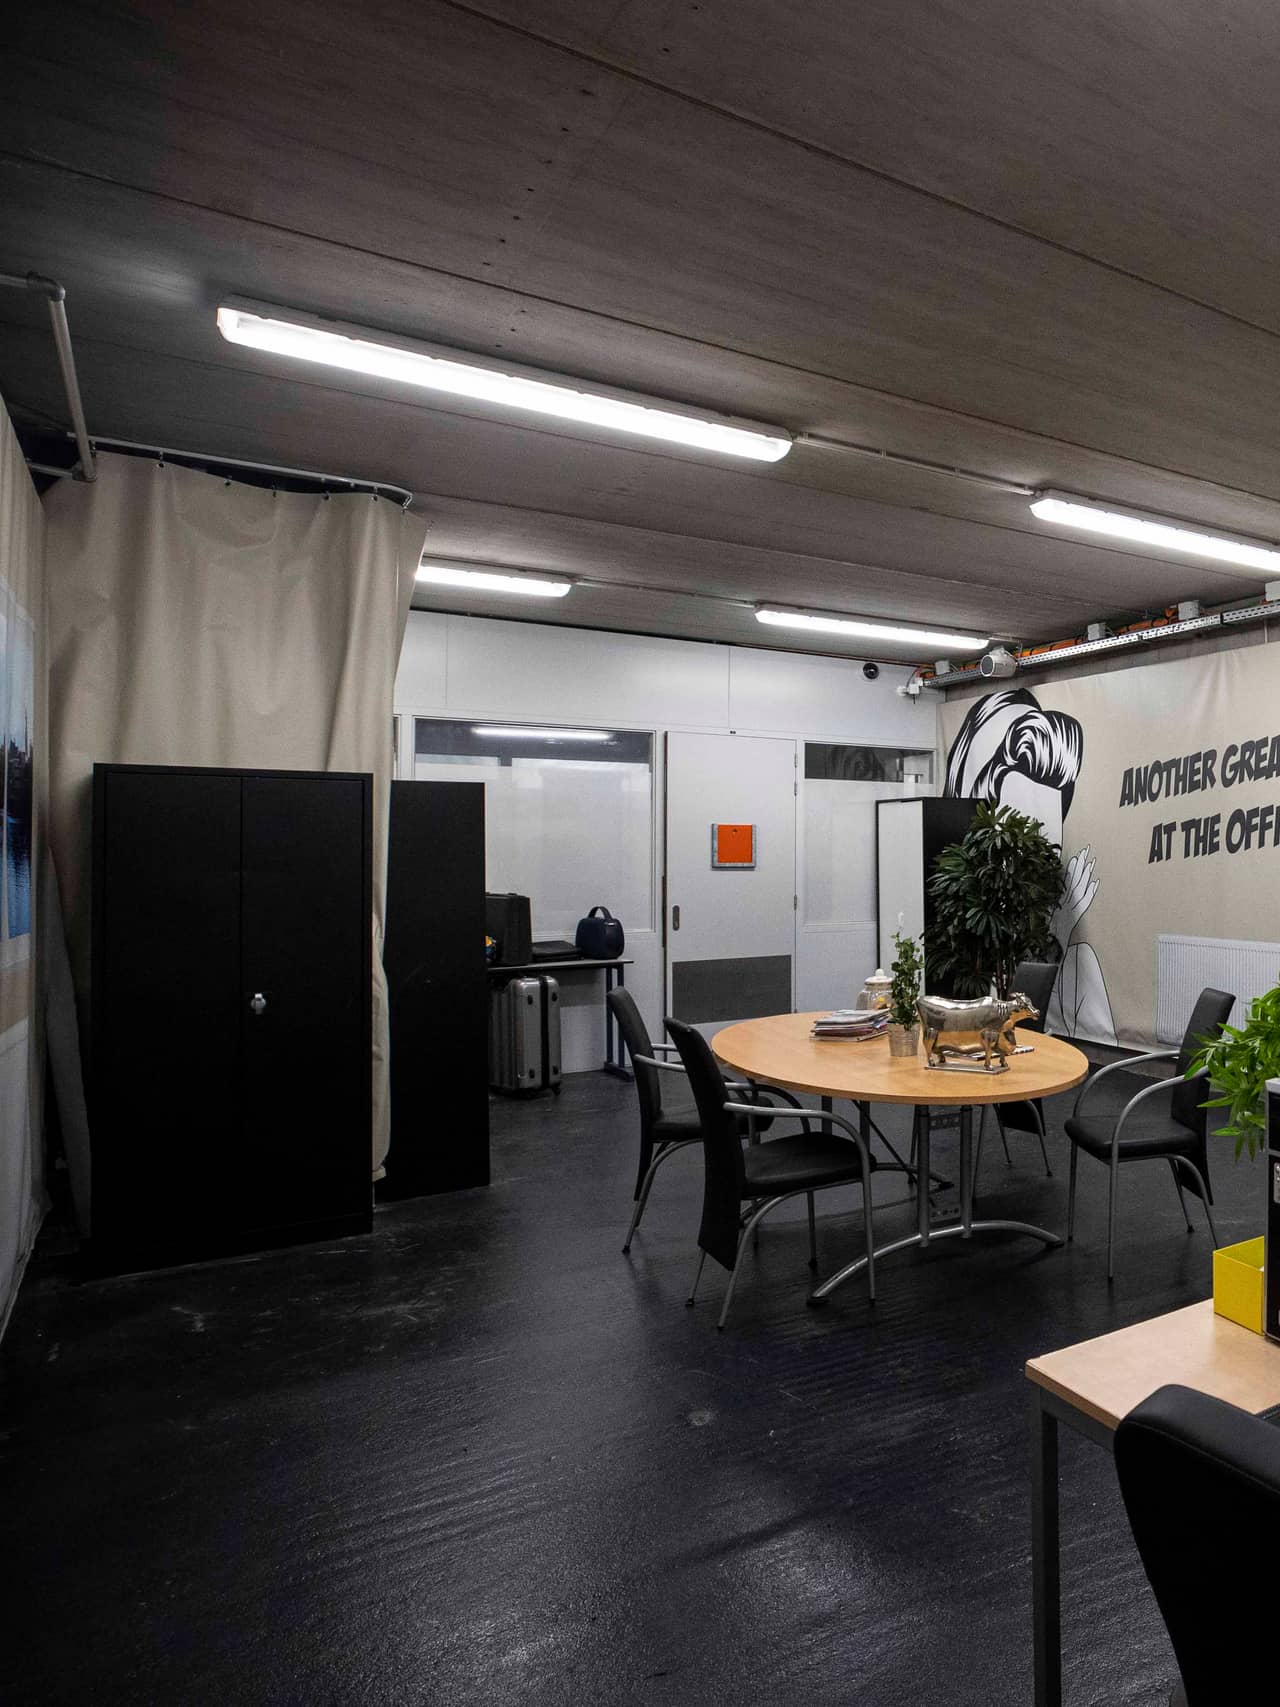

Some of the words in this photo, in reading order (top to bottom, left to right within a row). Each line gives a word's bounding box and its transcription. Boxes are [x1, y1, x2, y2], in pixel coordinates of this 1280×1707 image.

[1119, 749, 1218, 808] ANOTHER
[1147, 821, 1177, 865] AT
[1181, 812, 1221, 859] THE
